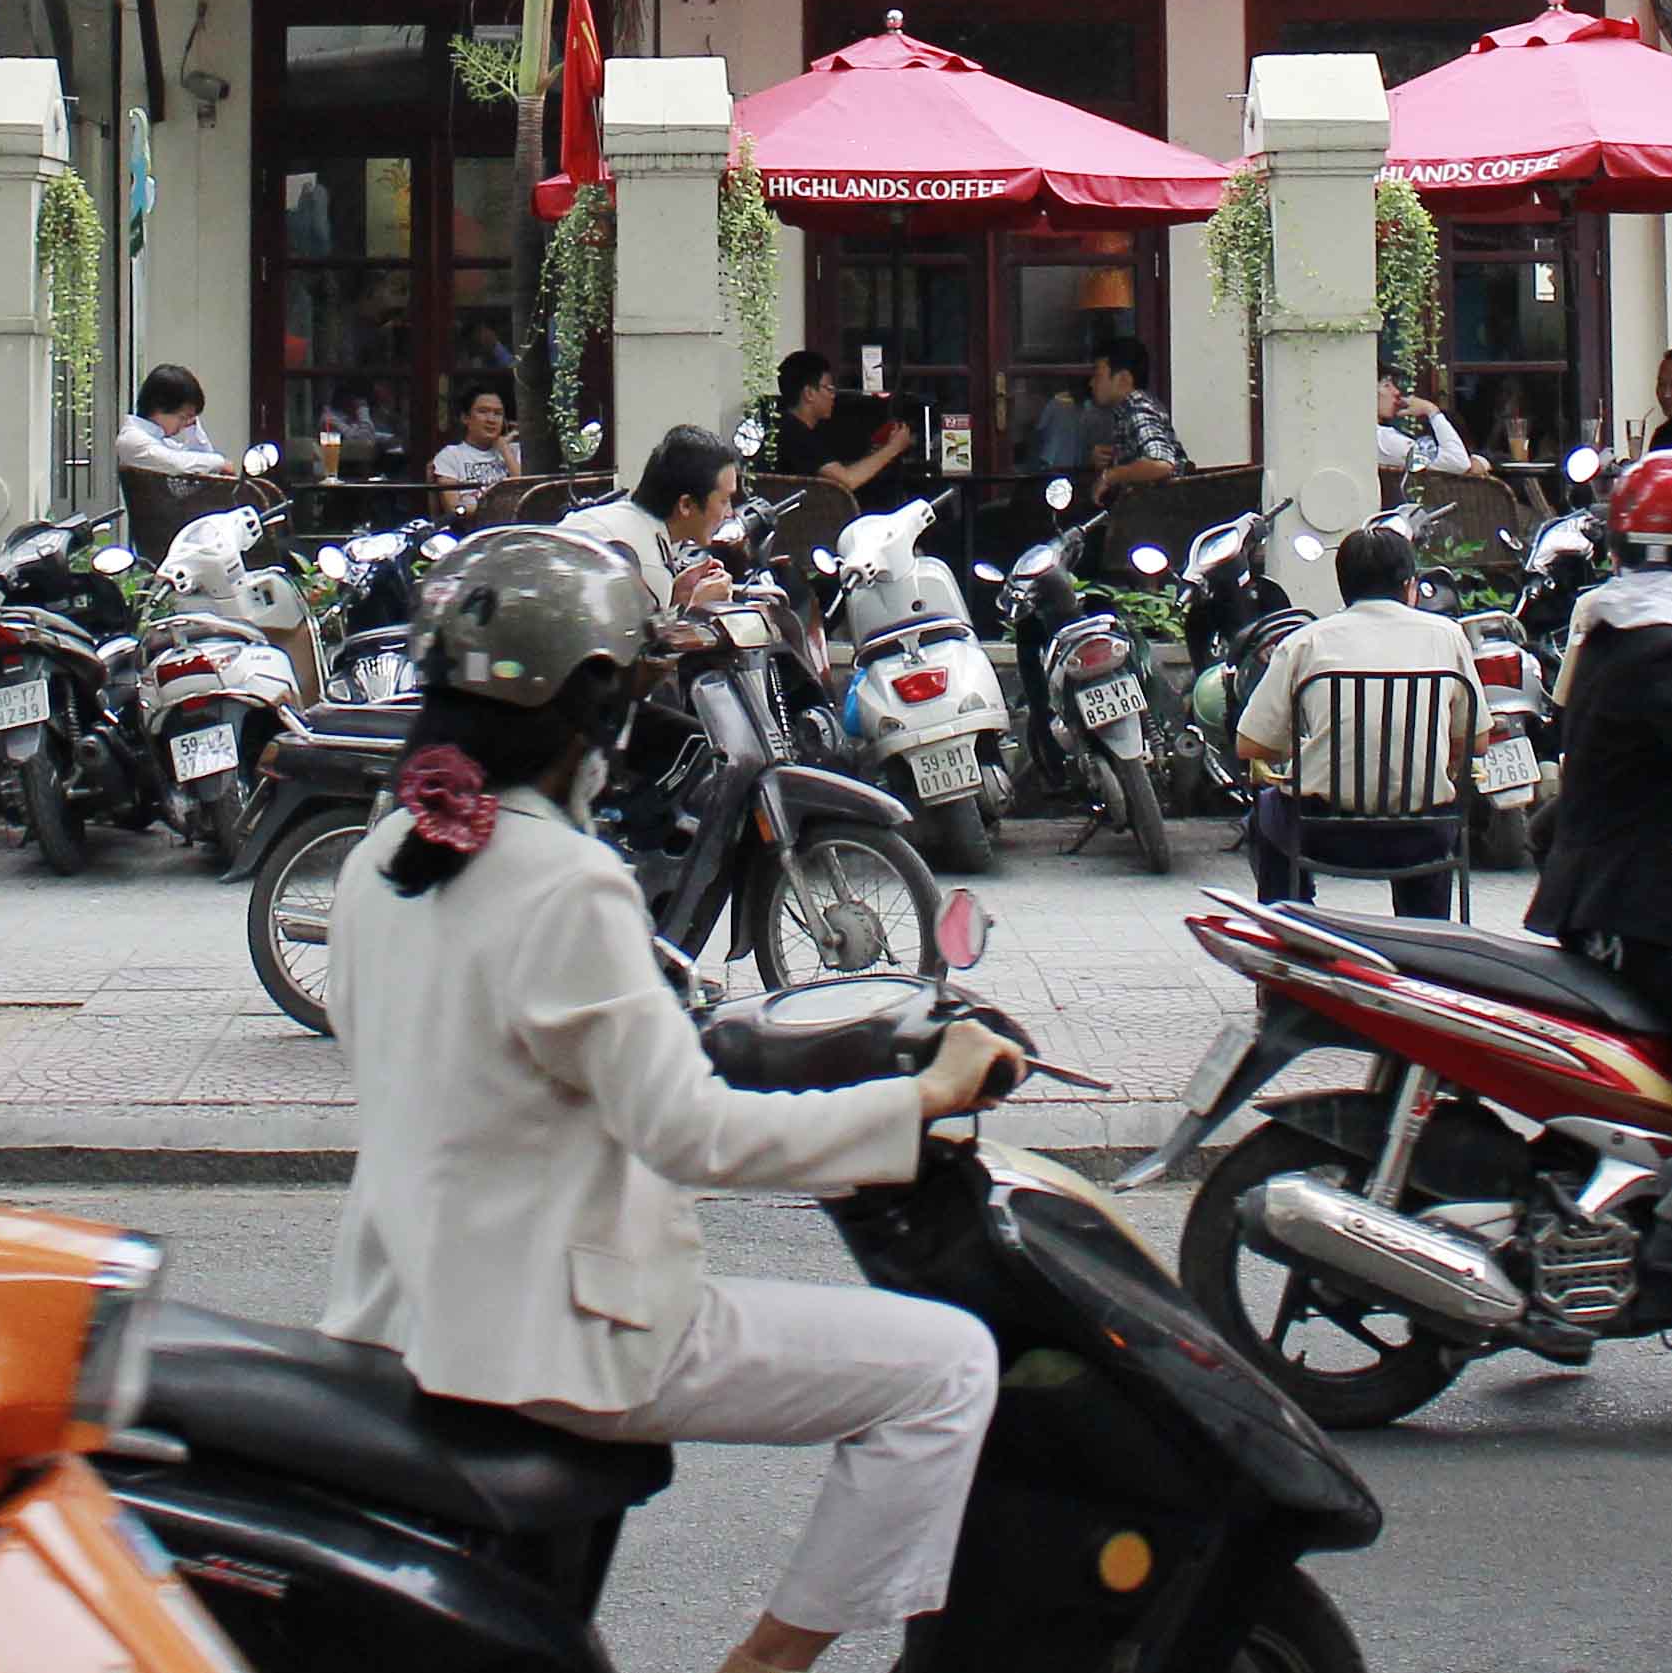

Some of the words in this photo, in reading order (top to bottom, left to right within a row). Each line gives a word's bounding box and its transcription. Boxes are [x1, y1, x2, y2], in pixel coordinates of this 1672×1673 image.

[1477, 152, 1562, 180] COFFEE
[768, 176, 910, 200] HIGHLANDS
[915, 178, 1008, 200] COFFEE
